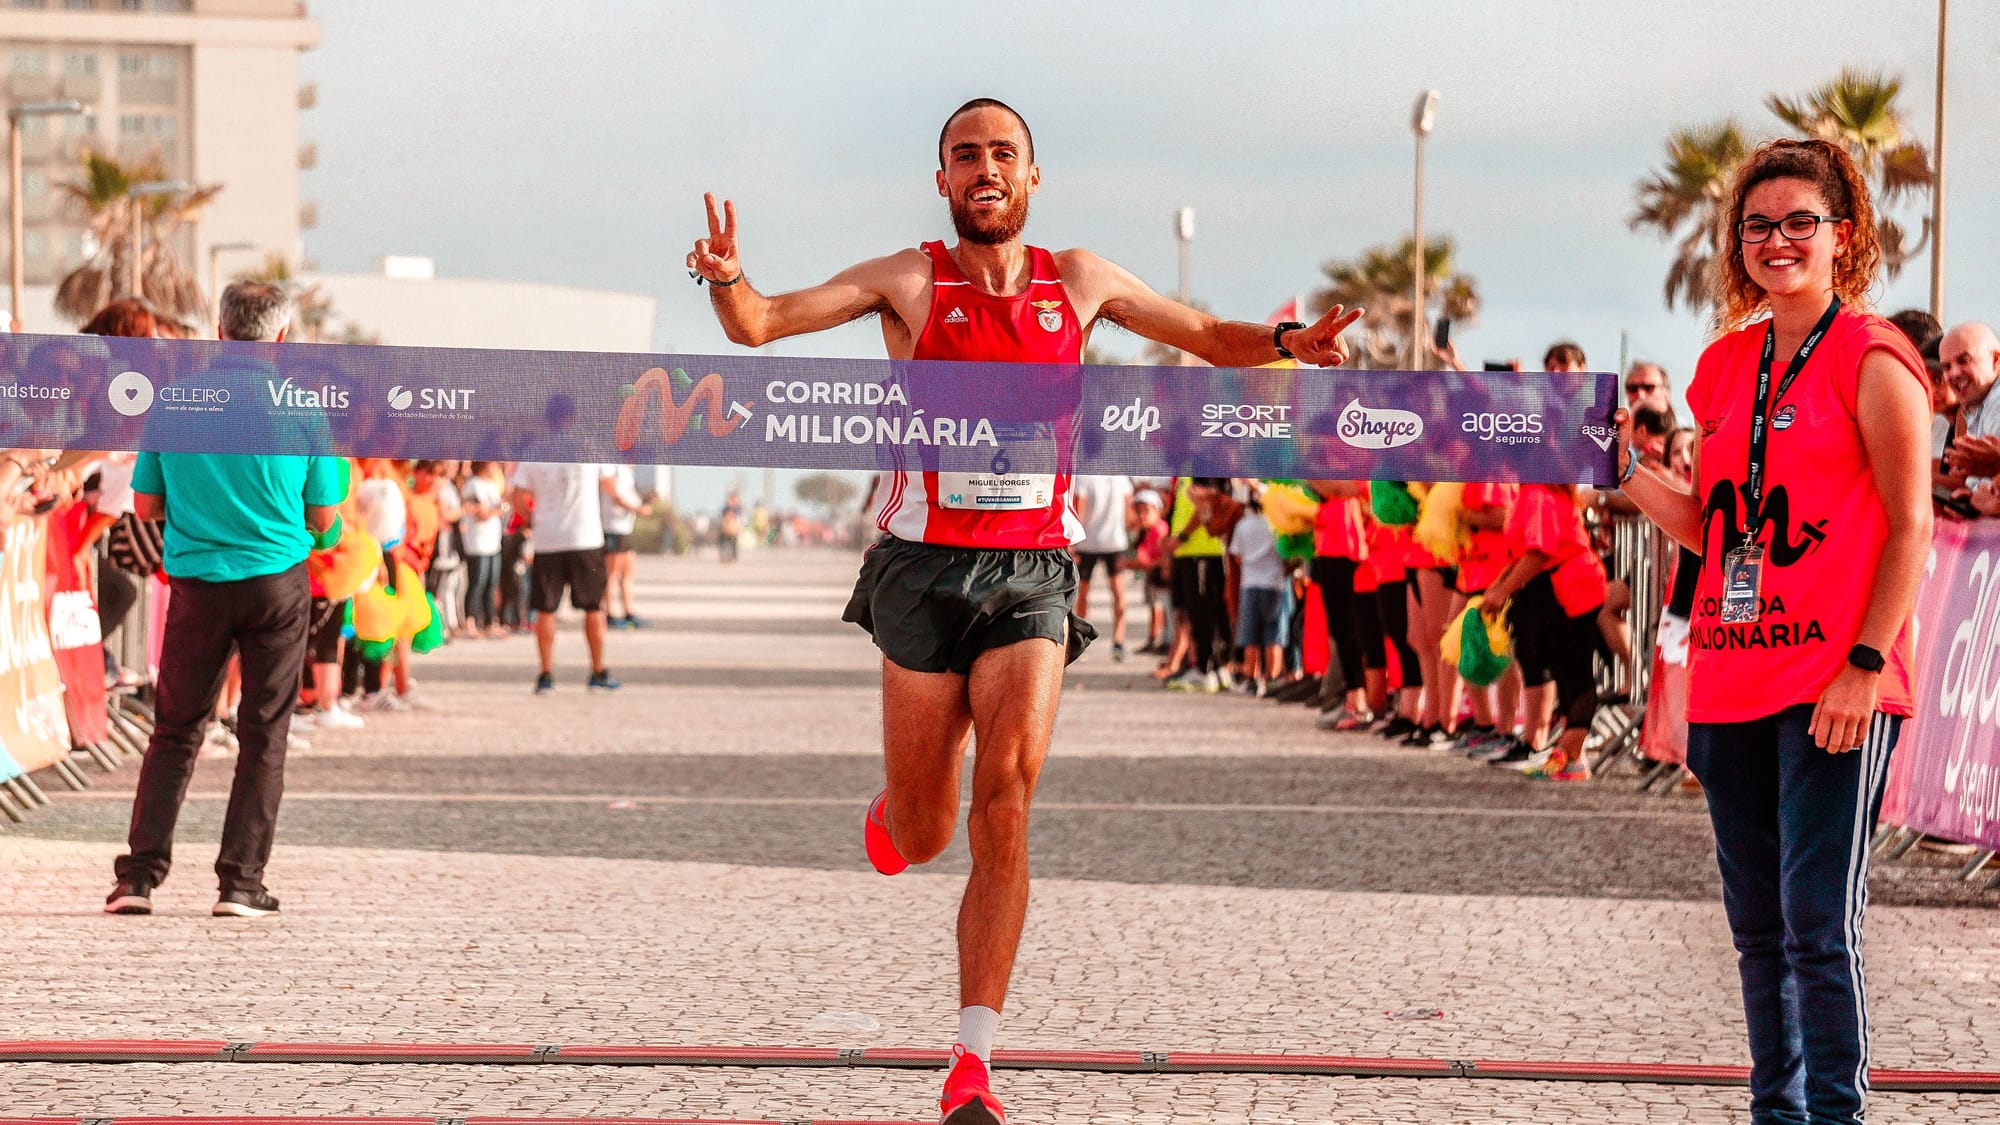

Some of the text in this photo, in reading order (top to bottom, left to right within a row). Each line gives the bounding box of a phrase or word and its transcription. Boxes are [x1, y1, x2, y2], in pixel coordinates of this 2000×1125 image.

[160, 387, 230, 403] CELEIRO
[267, 377, 350, 409] Vitalis
[420, 388, 475, 410] SNT
[766, 381, 908, 406] CORRIDA
[1100, 397, 1161, 441] edp
[1202, 404, 1292, 421] SPORT
[765, 408, 998, 447] MILIONÁRIA
[1201, 421, 1291, 439] ZONE
[1341, 409, 1417, 446] Shoyce
[1461, 412, 1543, 441] ageas
[1582, 425, 1605, 436] asa
[1495, 435, 1541, 446] seguros
[990, 449, 1011, 475] 6
